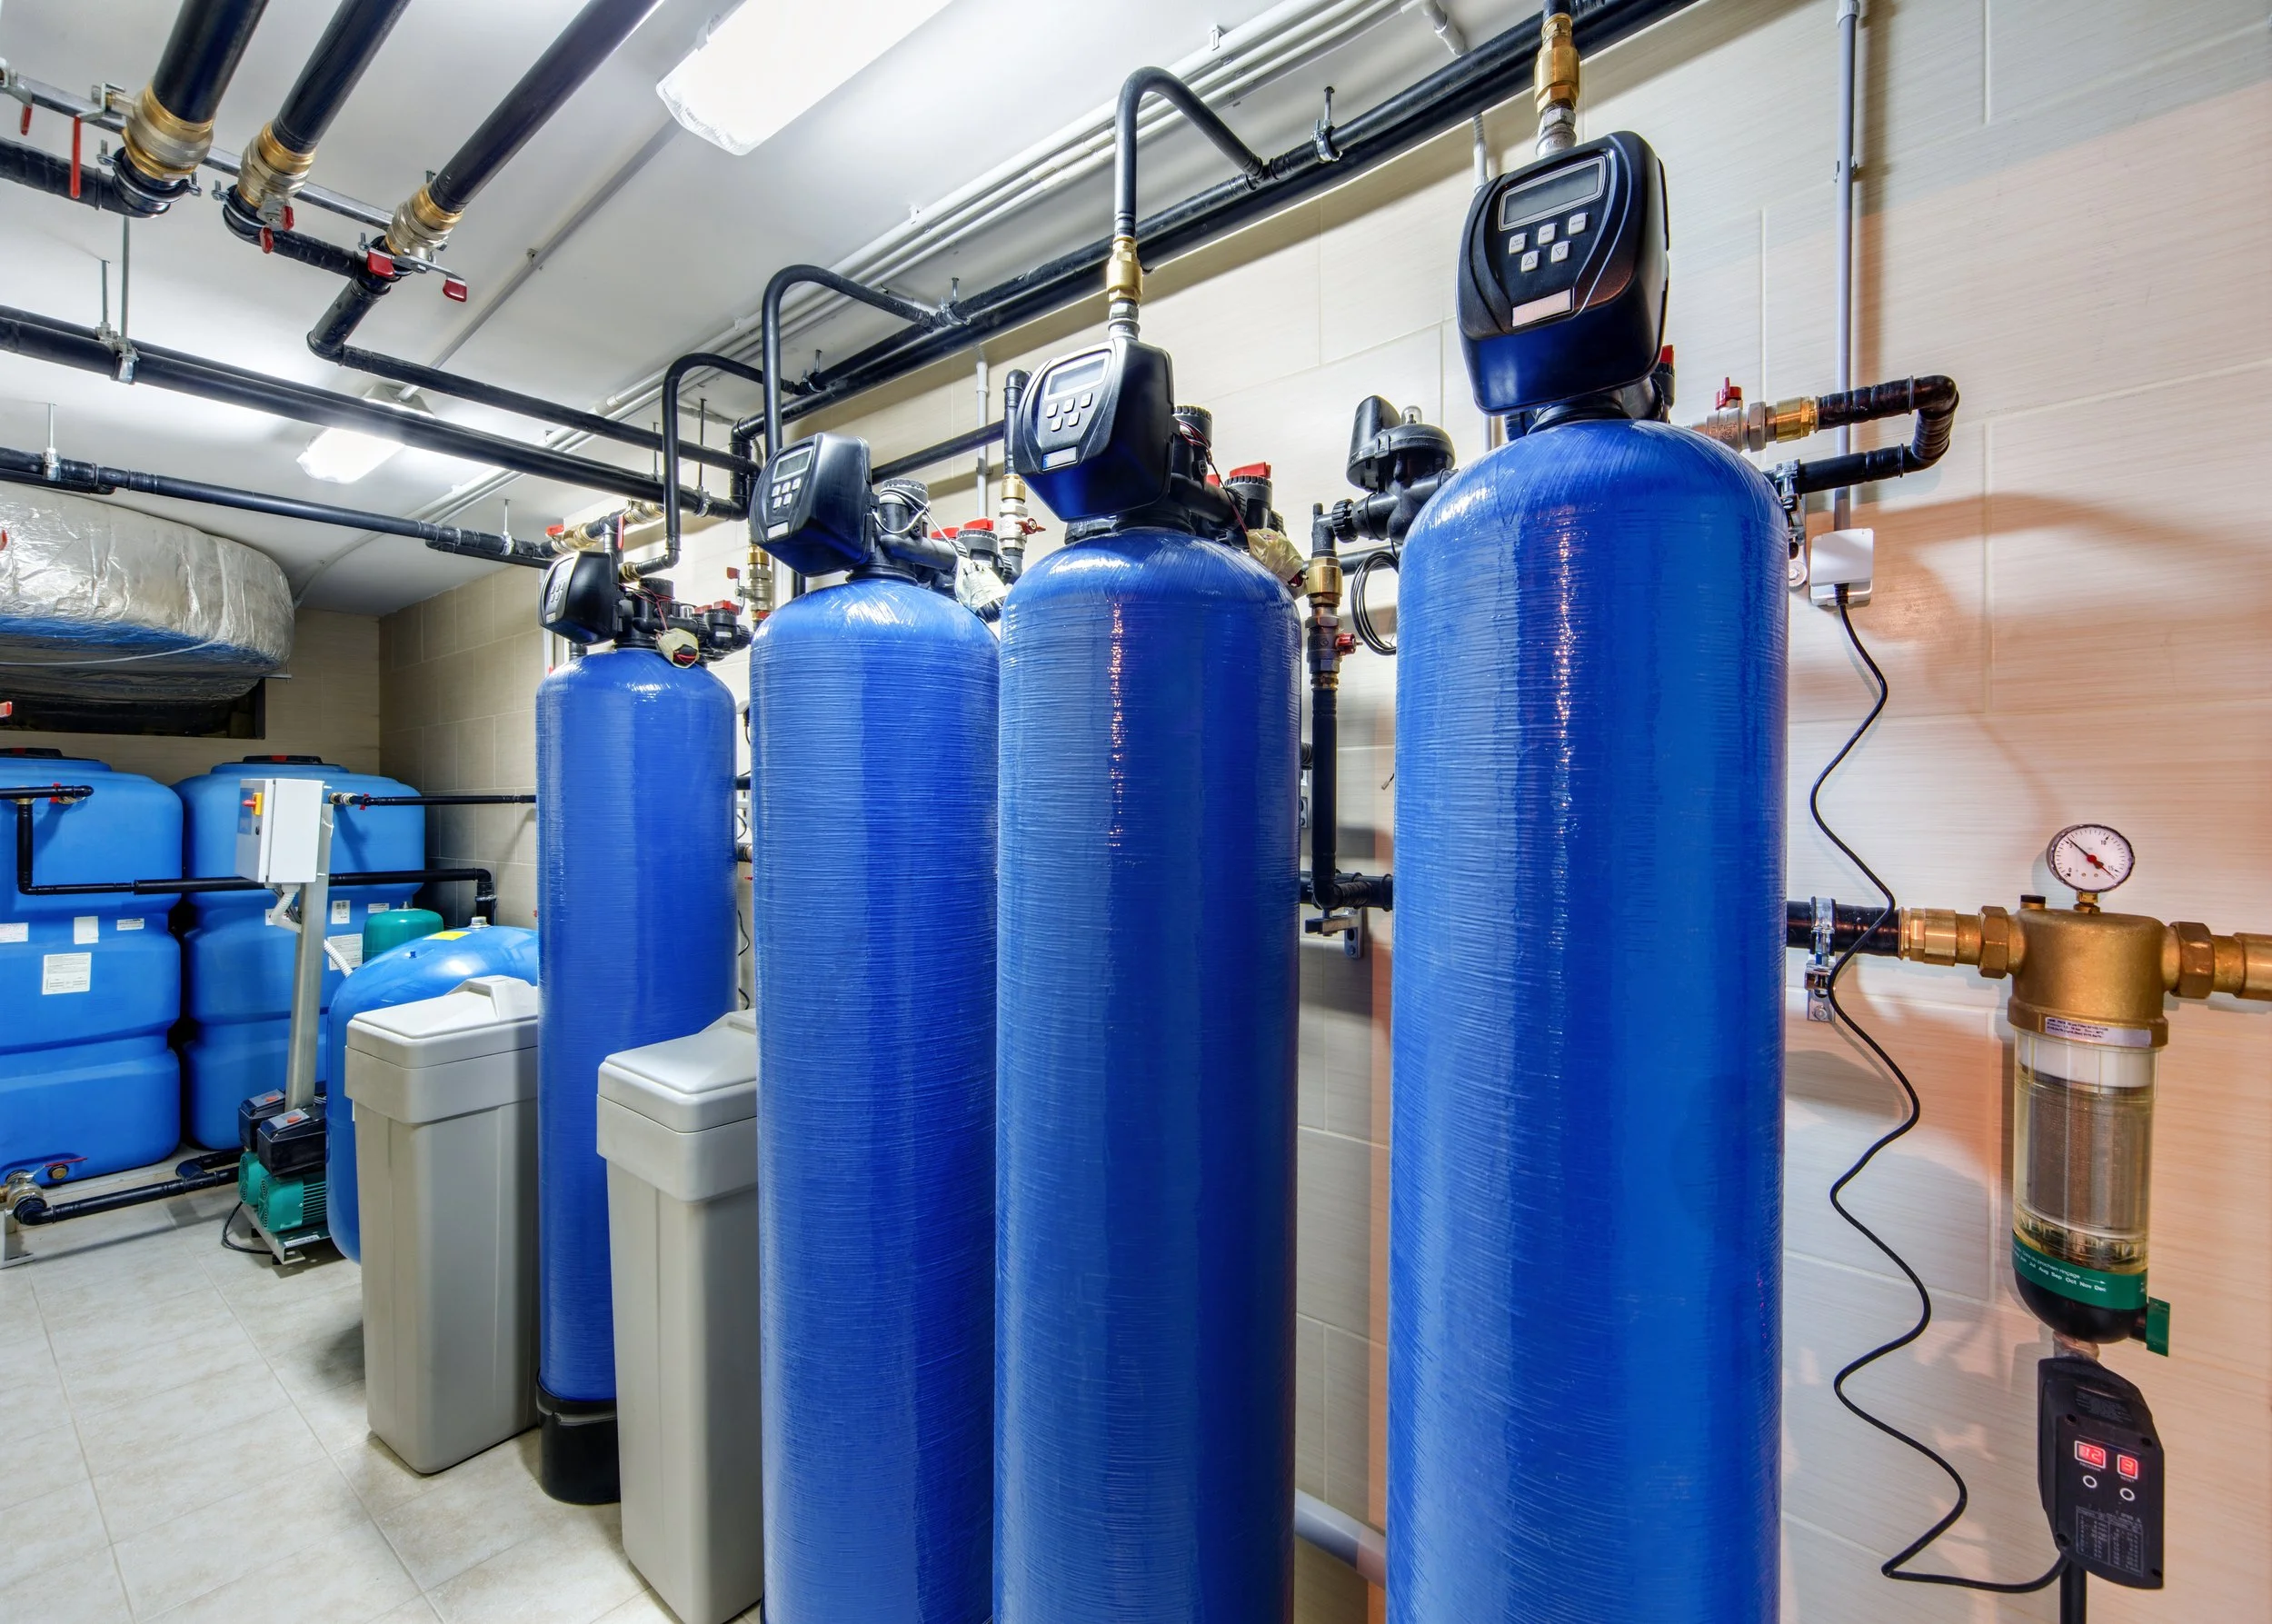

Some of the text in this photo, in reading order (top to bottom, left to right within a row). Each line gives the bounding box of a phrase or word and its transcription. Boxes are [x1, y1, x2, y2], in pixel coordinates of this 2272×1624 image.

[2038, 1260, 2058, 1272] prochain
[2059, 1269, 2080, 1280] rinçage
[2038, 1266, 2049, 1276] Aug
[2051, 1271, 2062, 1280] Sep
[2065, 1277, 2078, 1285] Oct
